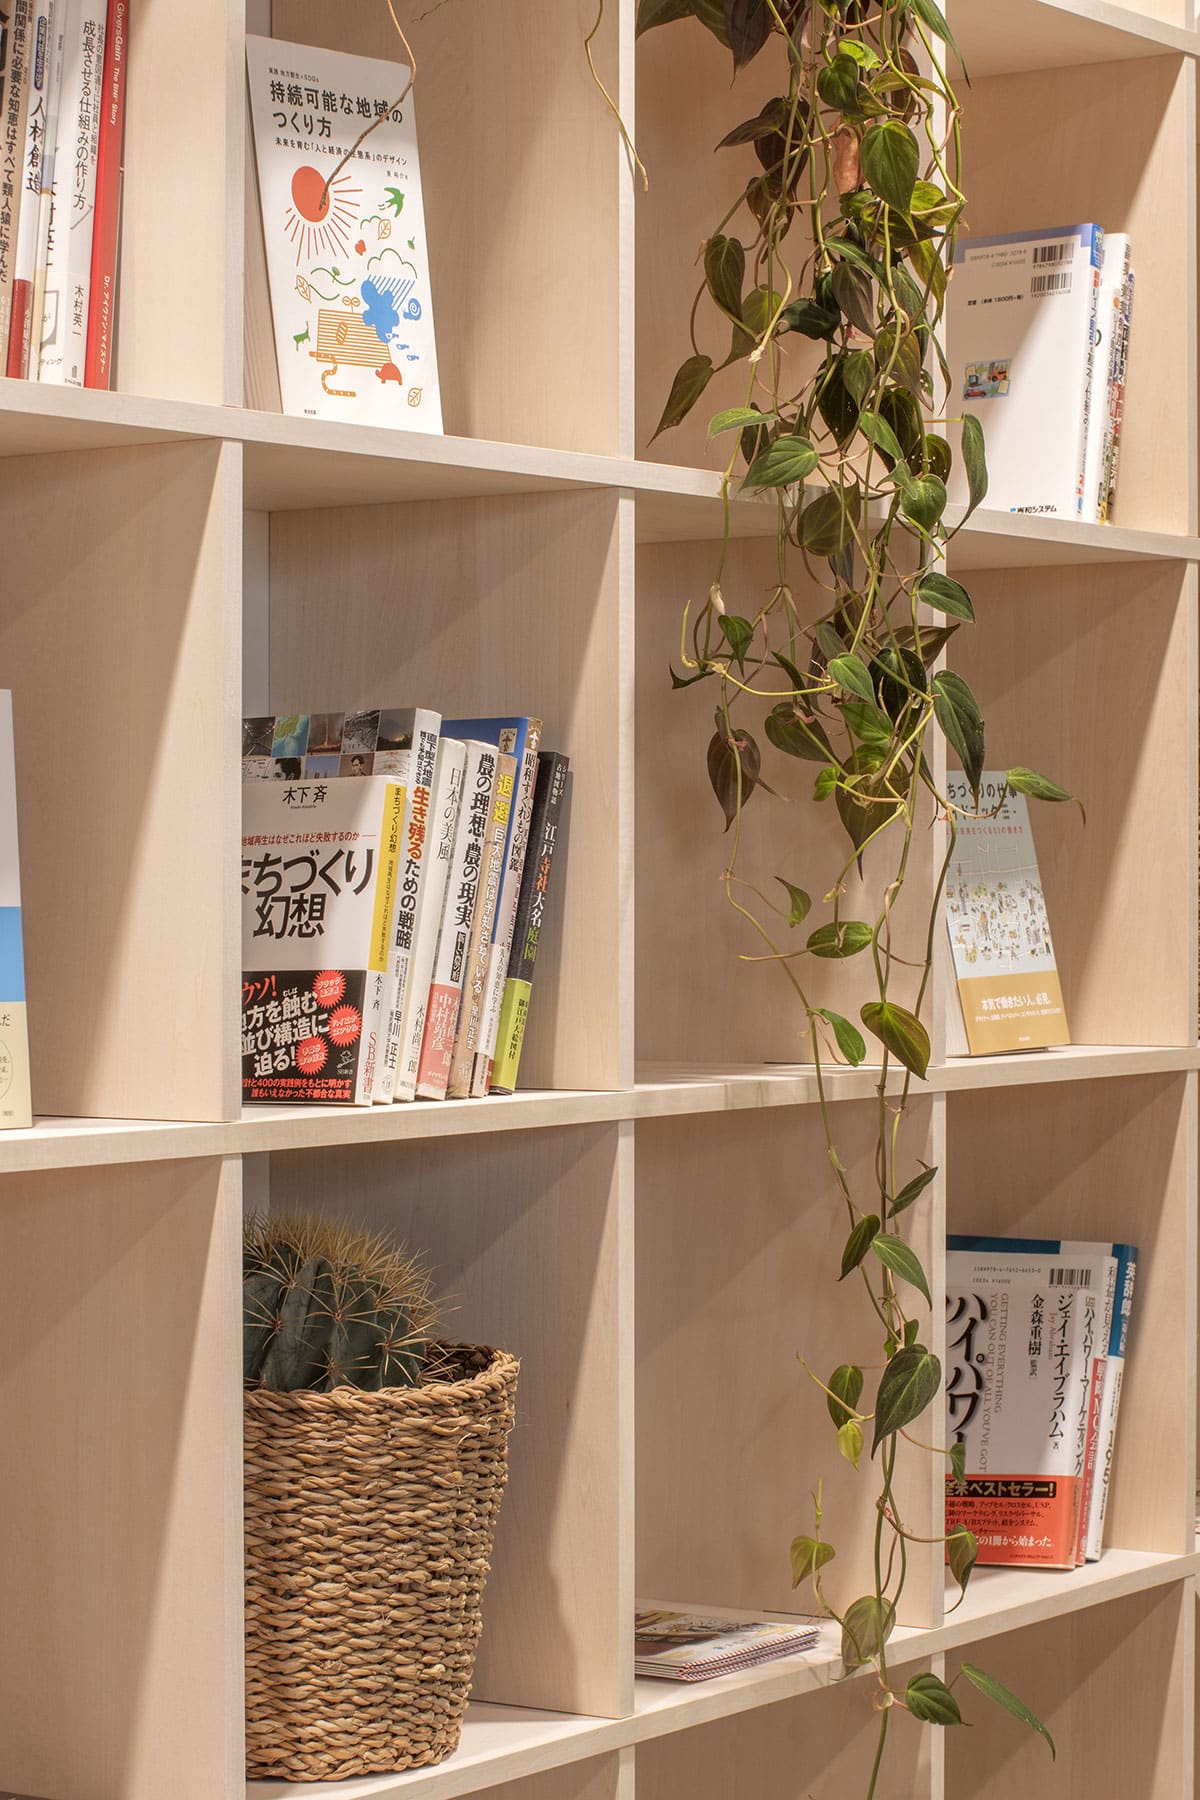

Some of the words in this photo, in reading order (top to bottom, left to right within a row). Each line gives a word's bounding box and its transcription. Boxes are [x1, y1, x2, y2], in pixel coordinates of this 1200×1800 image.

[73, 20, 96, 210] 成長させる仕組みの作り方
[270, 80, 403, 124] 持続可能な地域の
[273, 111, 332, 138] つくり方
[455, 753, 496, 928] 農の理想・農の現実
[397, 786, 431, 949] 生き残るための戦略
[253, 893, 327, 940] 幻想
[523, 822, 558, 963] 江戸寺社大名庭園
[254, 1045, 297, 1077] 迫る!
[990, 1293, 998, 1316] YOU
[999, 1292, 1008, 1341] GETTING
[1028, 1294, 1044, 1355] 金森重樹
[988, 1318, 997, 1341] CAN
[986, 1343, 996, 1366] OUT
[994, 1344, 1006, 1413] EVERYTHING
[1049, 1293, 1073, 1438] ジェイ・エイブラハム
[983, 1386, 992, 1405] ALL
[1075, 1308, 1095, 1477] ハイパワー・マーケティング
[979, 1448, 988, 1472] GOT
